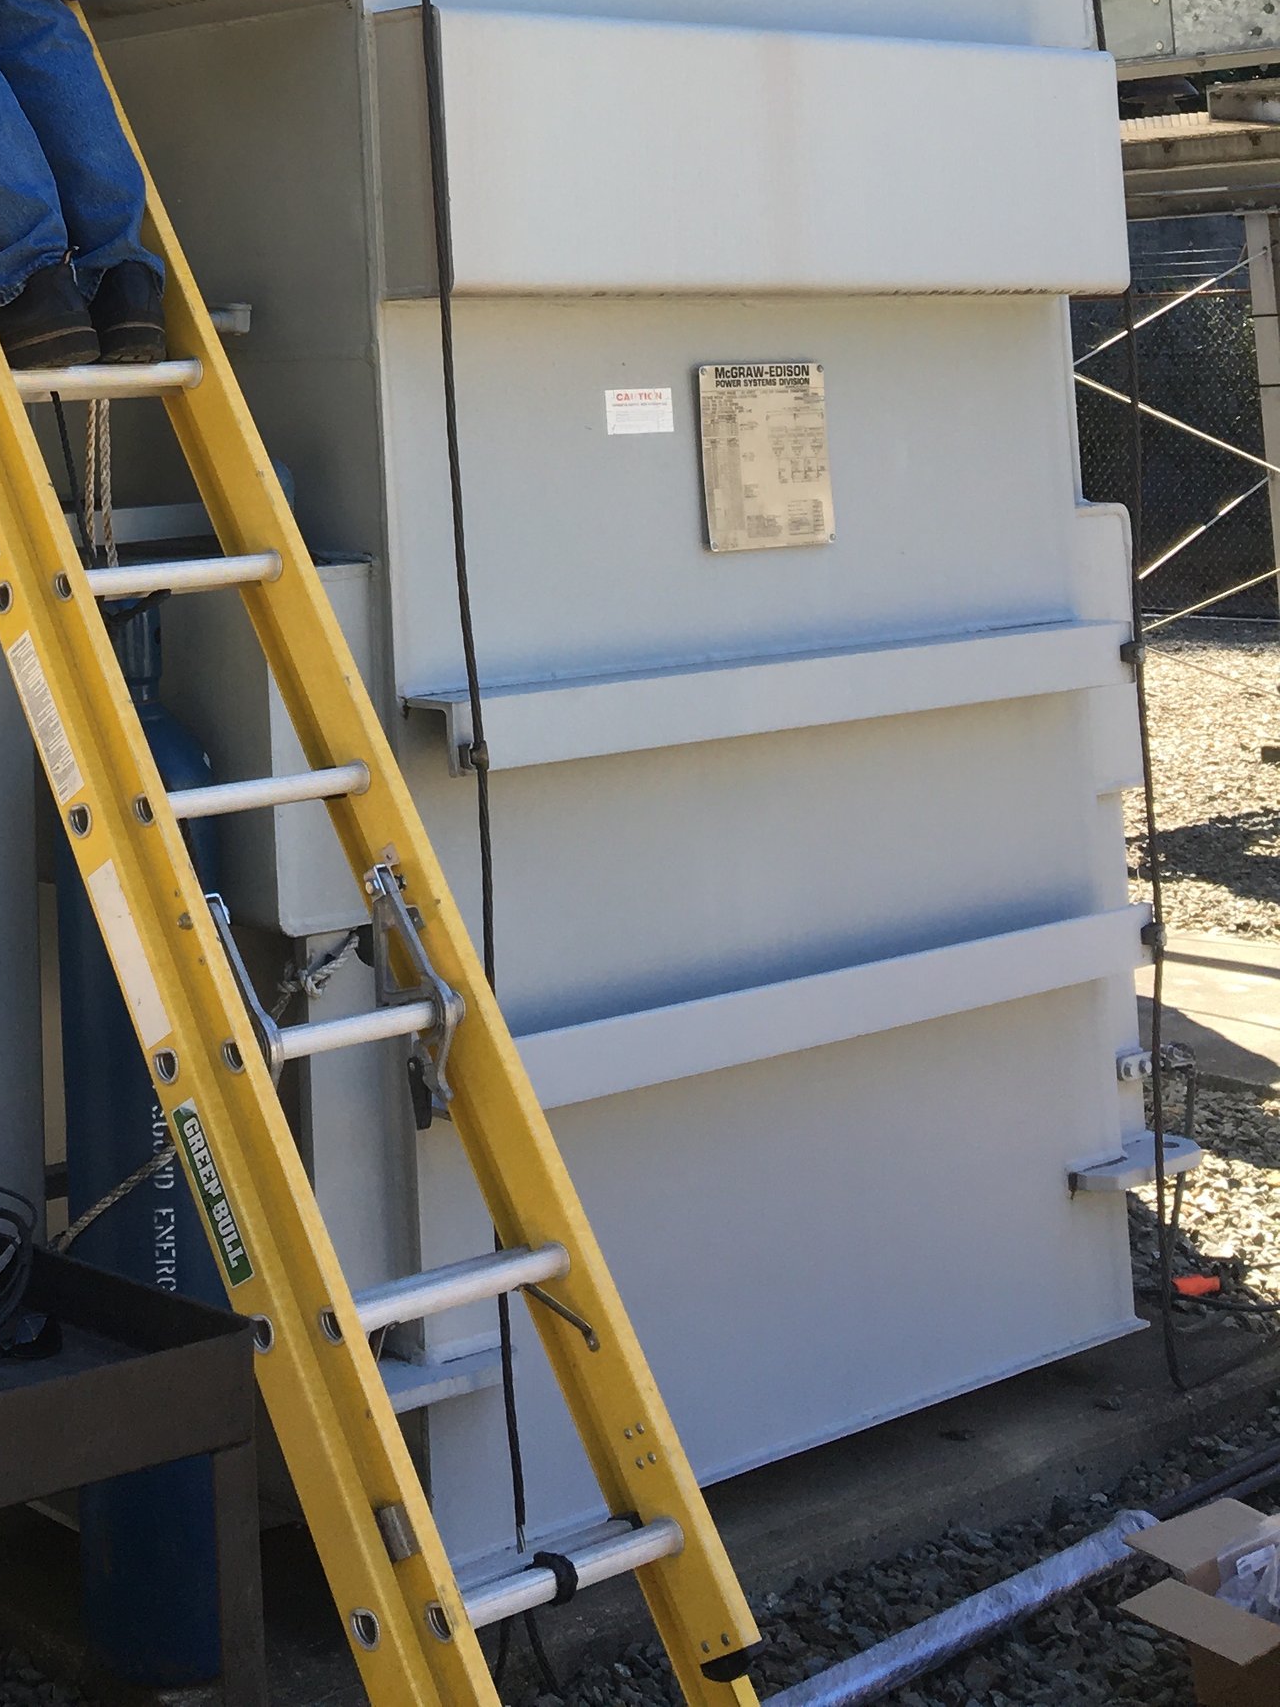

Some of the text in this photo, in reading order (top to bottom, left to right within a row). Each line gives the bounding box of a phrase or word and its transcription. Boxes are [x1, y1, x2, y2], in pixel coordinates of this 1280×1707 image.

[714, 364, 810, 379] McGRAW-EDISON
[715, 377, 810, 388] POWER SYSTEMS DIVISION
[183, 1117, 244, 1268] GREEN BULL
[154, 1208, 176, 1292] ENERG
